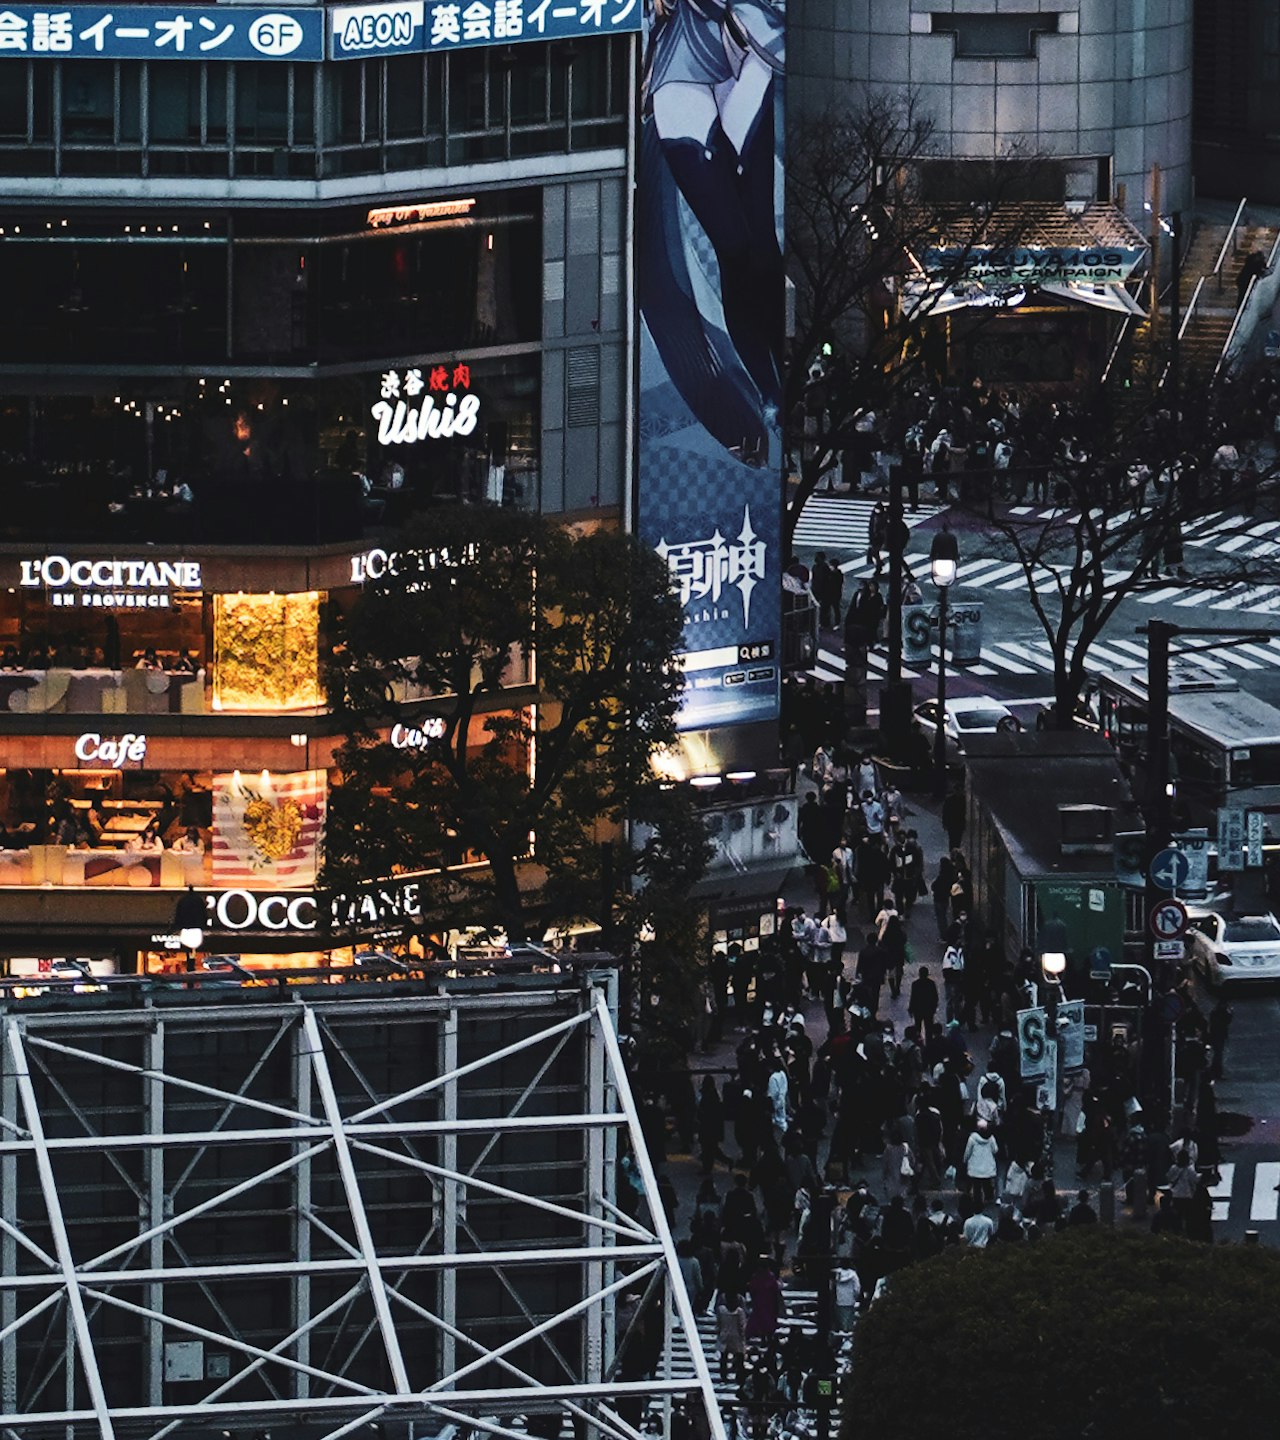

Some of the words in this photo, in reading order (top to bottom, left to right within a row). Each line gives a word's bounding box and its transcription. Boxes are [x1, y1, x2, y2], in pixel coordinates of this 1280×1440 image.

[256, 19, 297, 50] 6F
[338, 9, 415, 48] AEON
[371, 391, 481, 446] Ushi8
[20, 554, 202, 588] L'OCCITANE
[52, 592, 77, 608] EN
[81, 591, 170, 608] PROVENCE
[74, 733, 147, 767] Café
